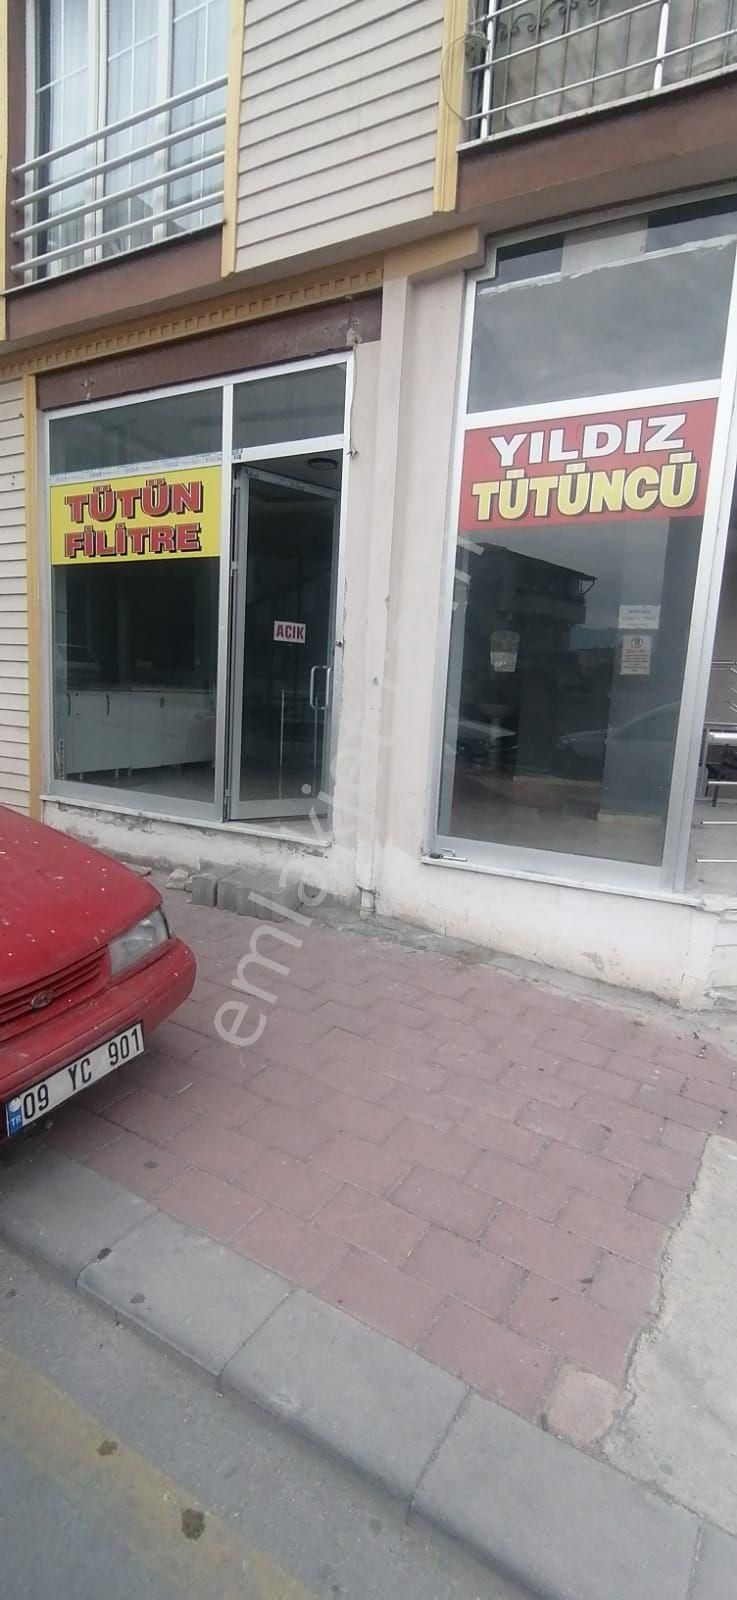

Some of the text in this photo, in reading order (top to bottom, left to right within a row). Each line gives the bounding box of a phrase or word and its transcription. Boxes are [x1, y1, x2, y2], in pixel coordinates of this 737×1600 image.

[490, 413, 688, 468] YILDIZ
[64, 477, 204, 524] TÜTÜN
[471, 451, 699, 523] TÜTÜNCÜ
[64, 522, 203, 560] FİLİTRE
[23, 1027, 141, 1120] 09 YC 901
